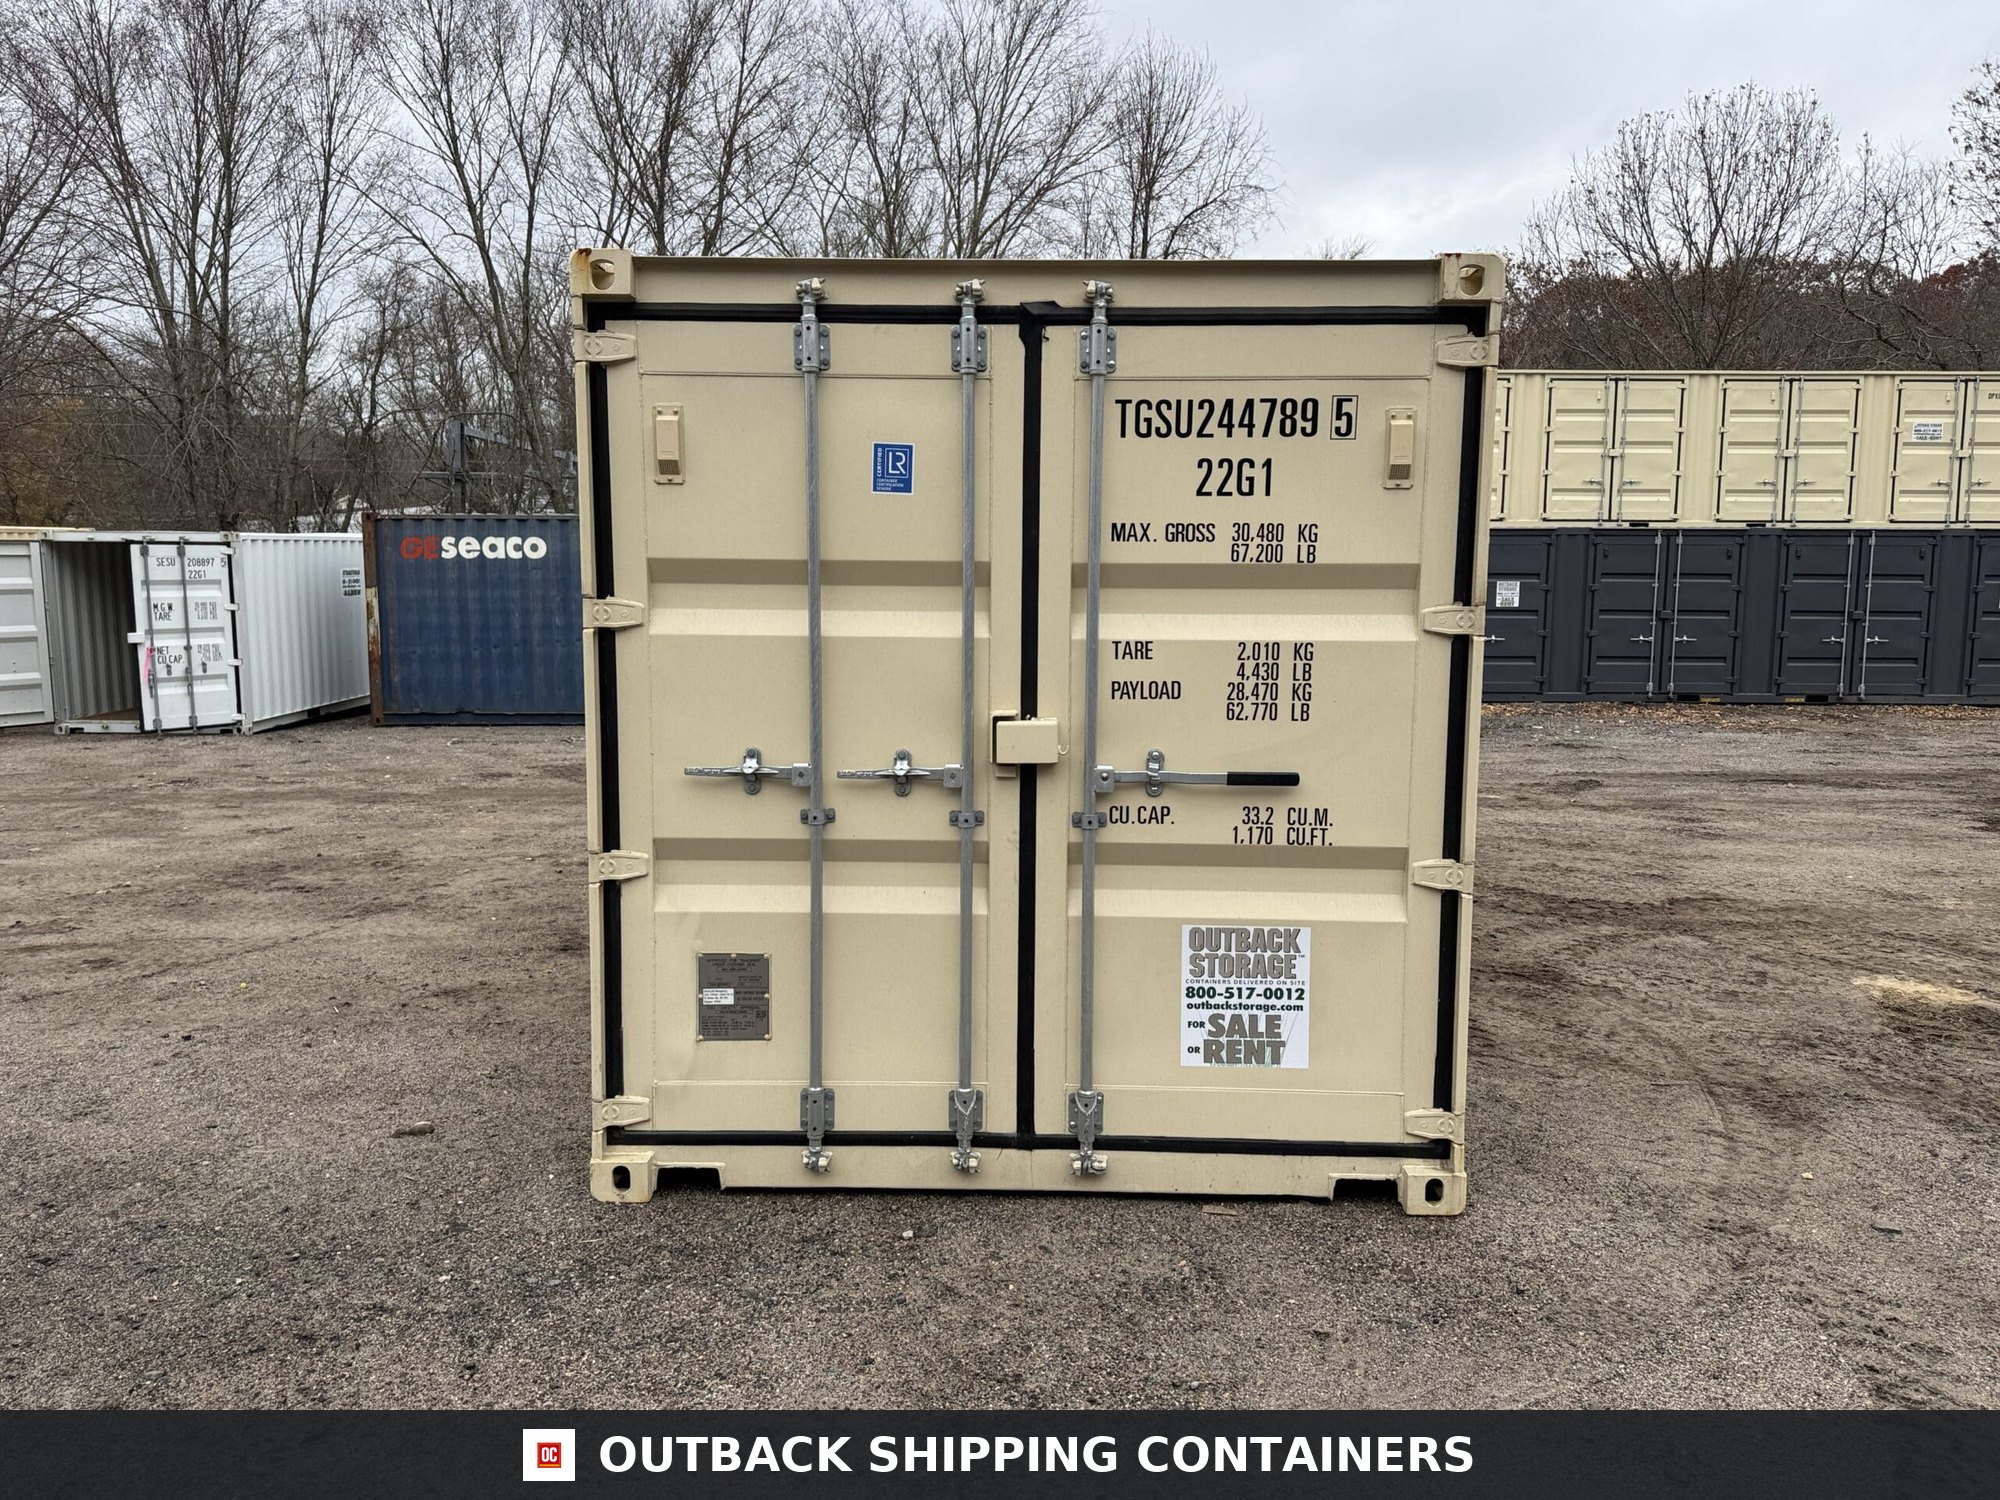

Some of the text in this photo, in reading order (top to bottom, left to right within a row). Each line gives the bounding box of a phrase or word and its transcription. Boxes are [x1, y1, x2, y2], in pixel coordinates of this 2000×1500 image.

[1115, 397, 1354, 438] TGSU244789 5
[889, 452, 906, 474] LR
[1196, 457, 1273, 497] 22G1
[1111, 522, 1319, 543] MAX. GROSS 30,480 KG
[156, 558, 176, 566] SESU
[1230, 543, 1317, 564] 67,200 LB
[188, 570, 206, 579] 22G1
[154, 612, 172, 621] TARE
[1111, 640, 1314, 662] TARE 2,010 KG
[1236, 662, 1312, 682] 4,430 LB
[1111, 680, 1313, 702] PAYLOAD 28,470 KG
[1226, 702, 1310, 722] 62,770 LB
[1108, 805, 1334, 827] CU.CAP. 33.2 CU.M.
[1232, 826, 1274, 846] 1,170
[1188, 927, 1301, 953] OUTBACK
[1189, 953, 1298, 979] STORAGE
[1186, 986, 1305, 1000] 800-517-0012
[1187, 1001, 1303, 1012] outbackstorage.com
[1208, 1013, 1282, 1038] SALE
[1188, 1040, 1286, 1065] OR RENT
